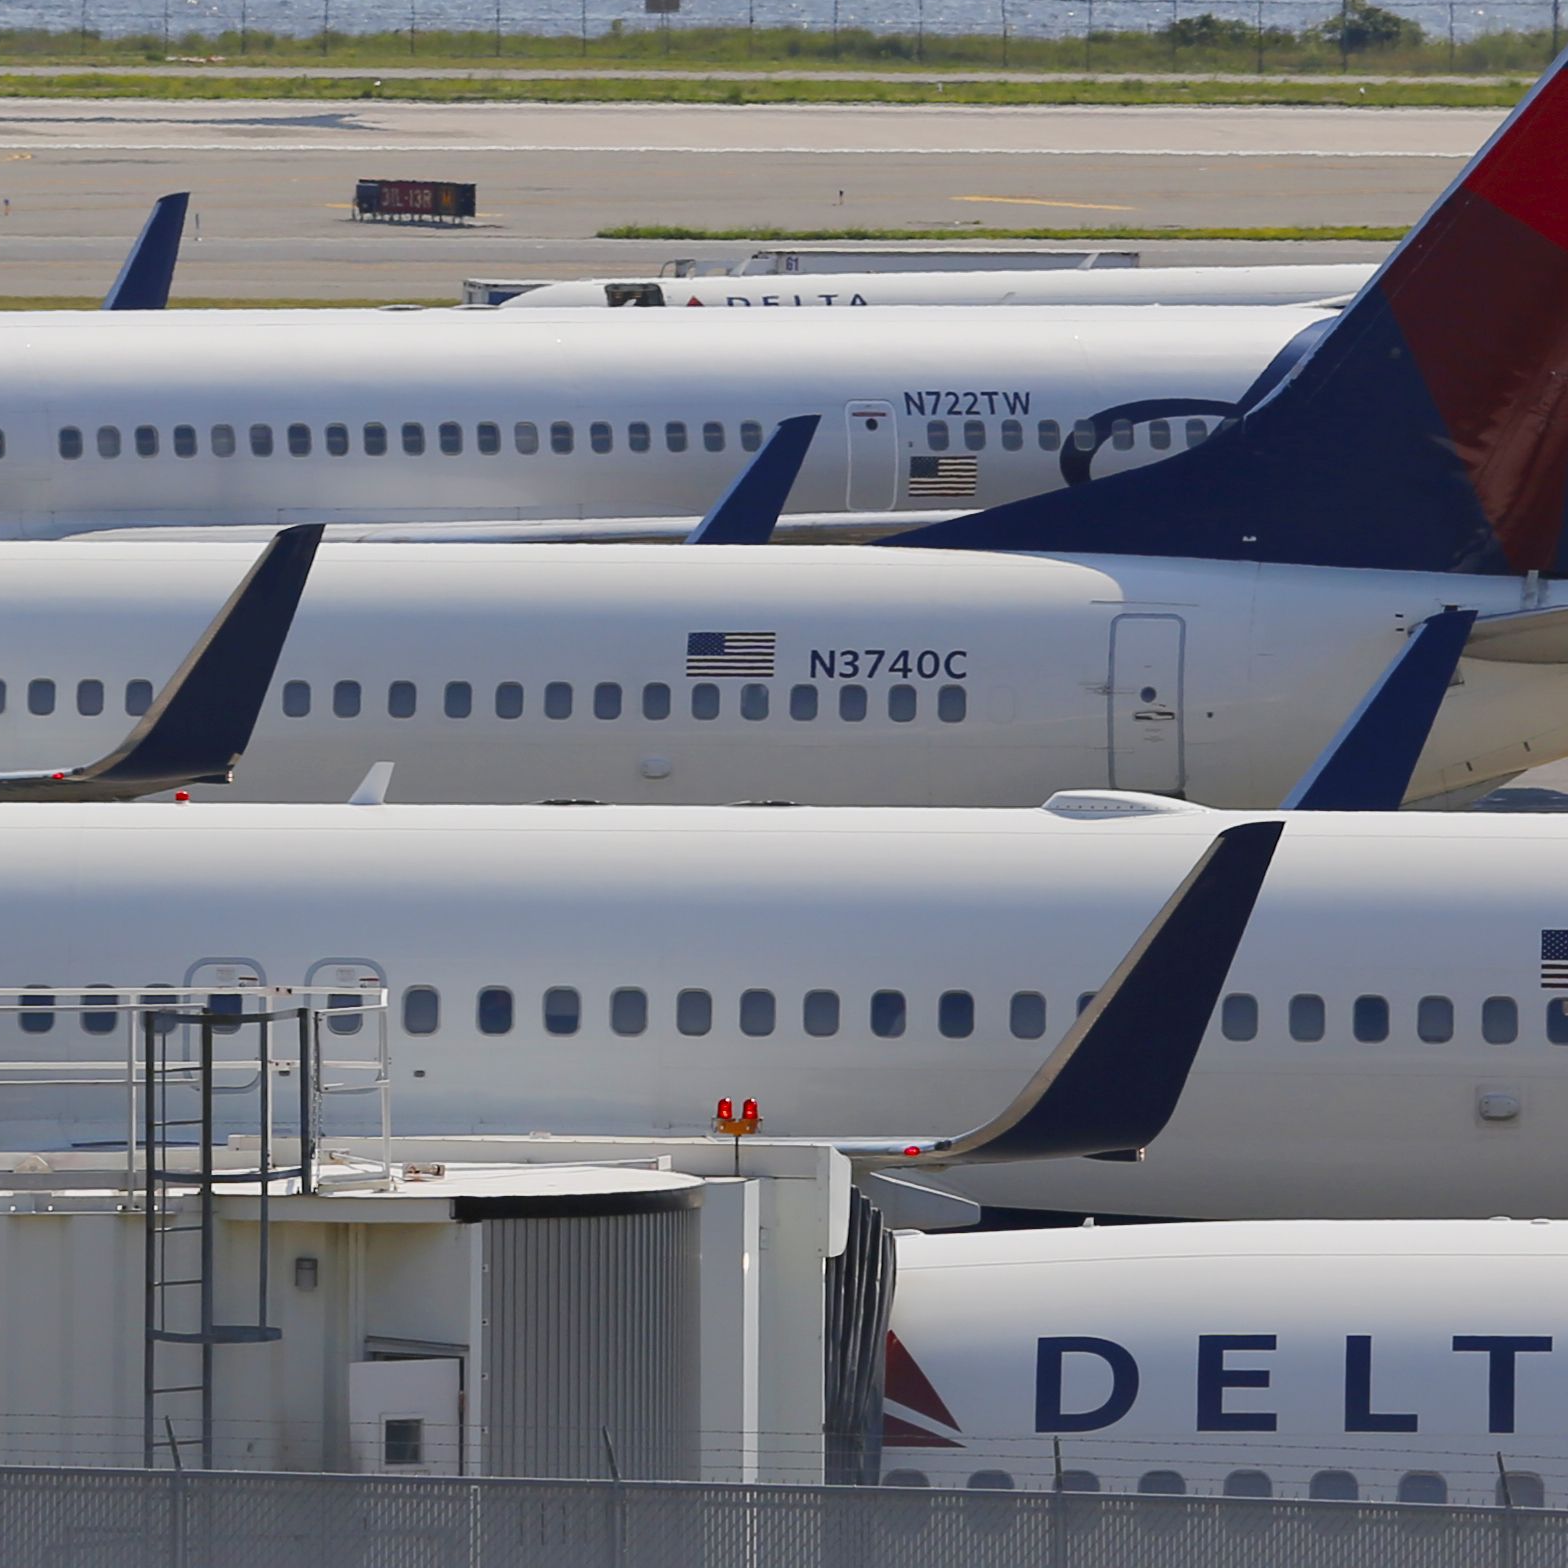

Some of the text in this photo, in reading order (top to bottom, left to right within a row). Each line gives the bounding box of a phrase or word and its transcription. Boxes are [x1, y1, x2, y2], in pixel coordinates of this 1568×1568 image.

[785, 257, 799, 271] 61
[904, 391, 1032, 416] N722TW
[809, 649, 968, 680] N3740C
